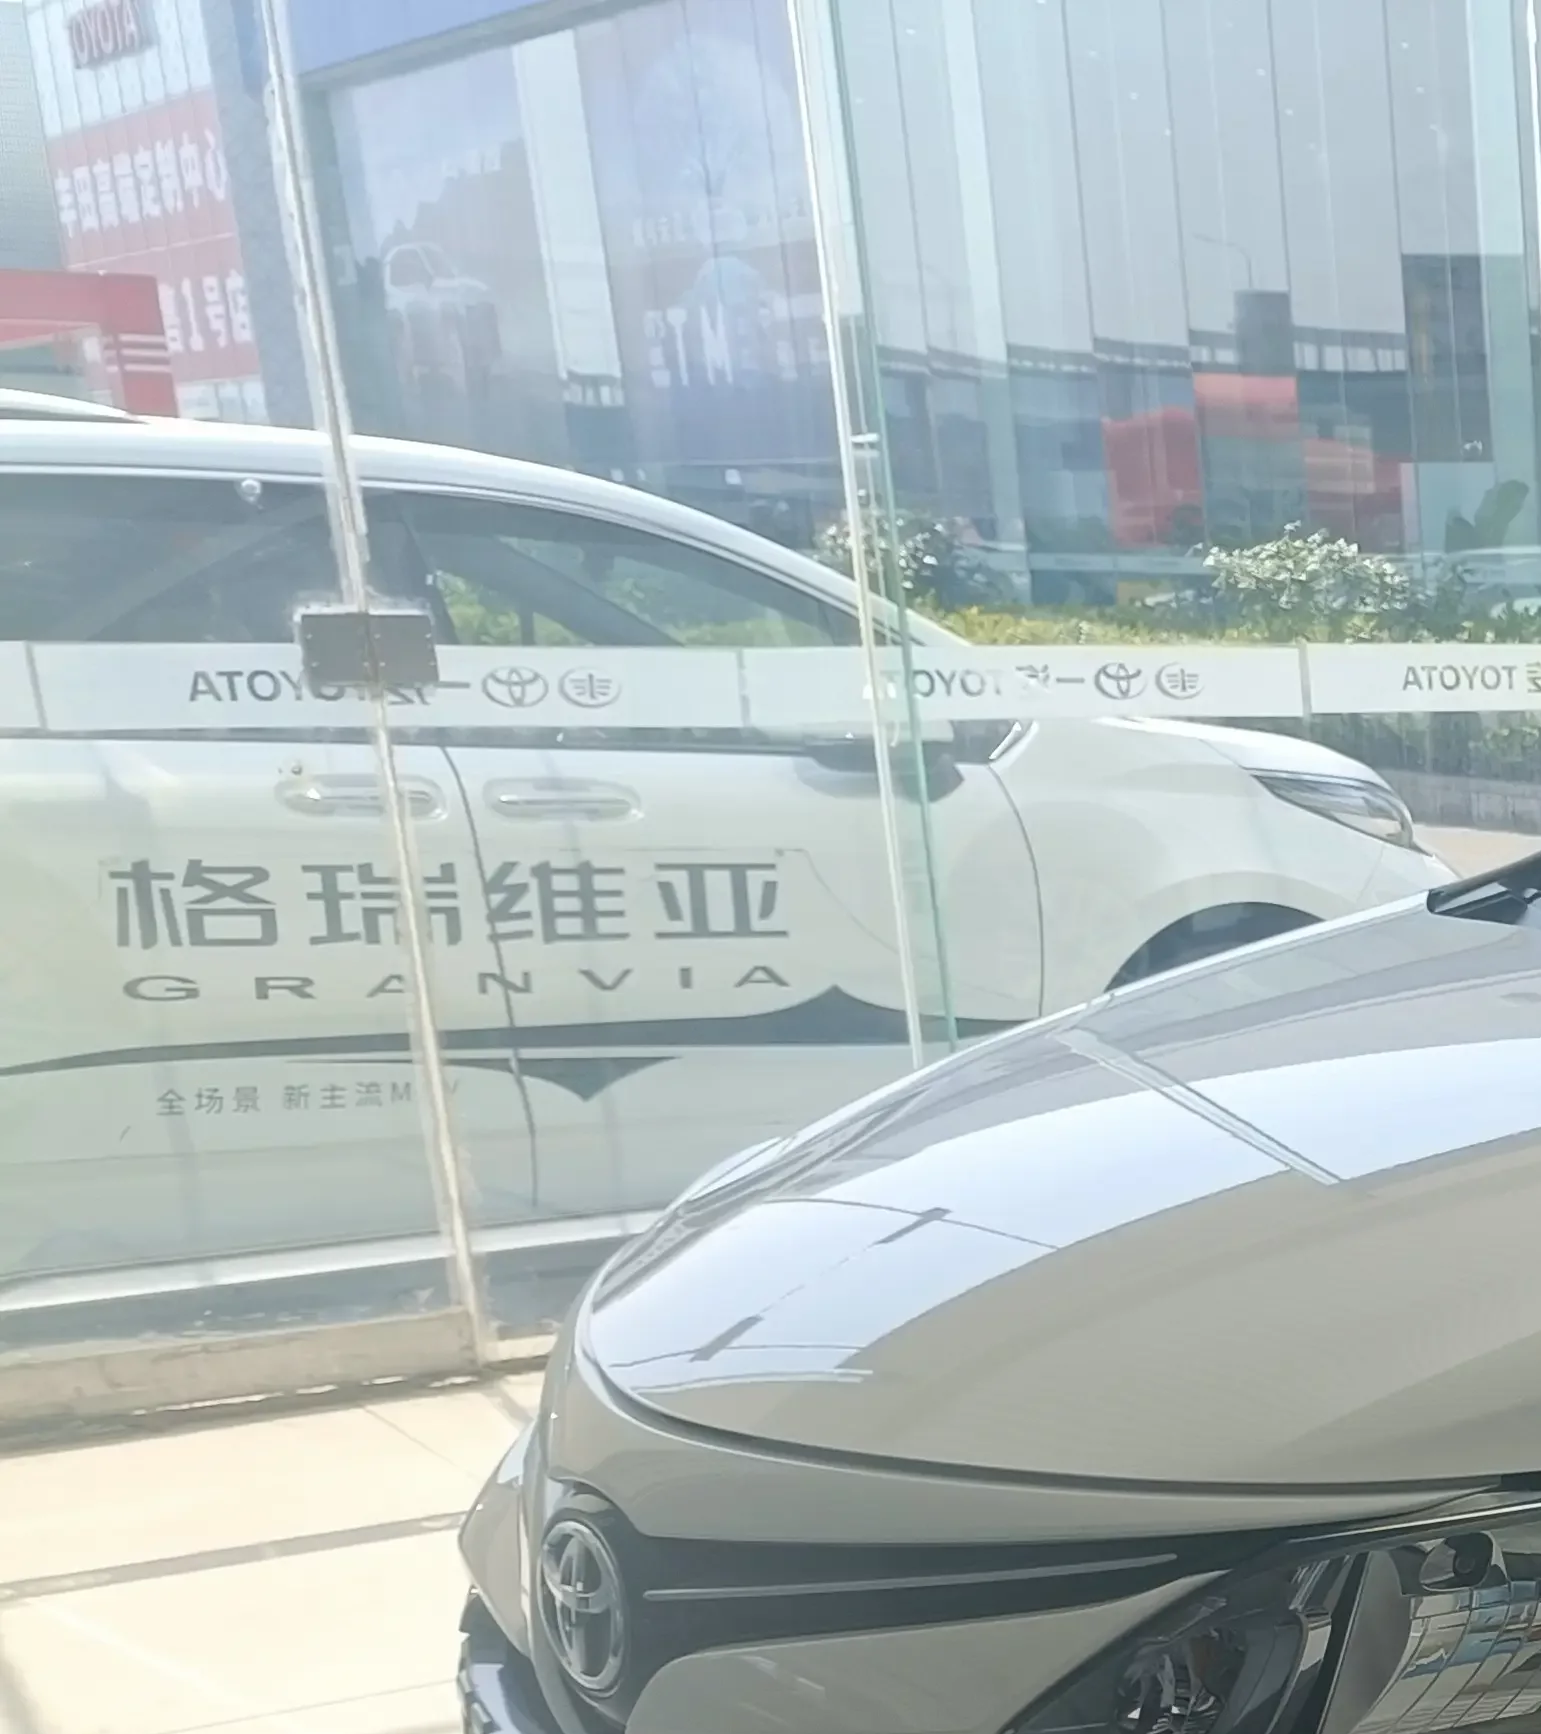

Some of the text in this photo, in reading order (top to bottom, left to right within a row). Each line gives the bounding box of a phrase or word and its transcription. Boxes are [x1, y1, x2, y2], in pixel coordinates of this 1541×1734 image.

[109, 858, 789, 949] 格瑞维亚
[122, 966, 790, 1002] GRANVIA
[156, 1077, 461, 1116] 全场景 新主流MV
